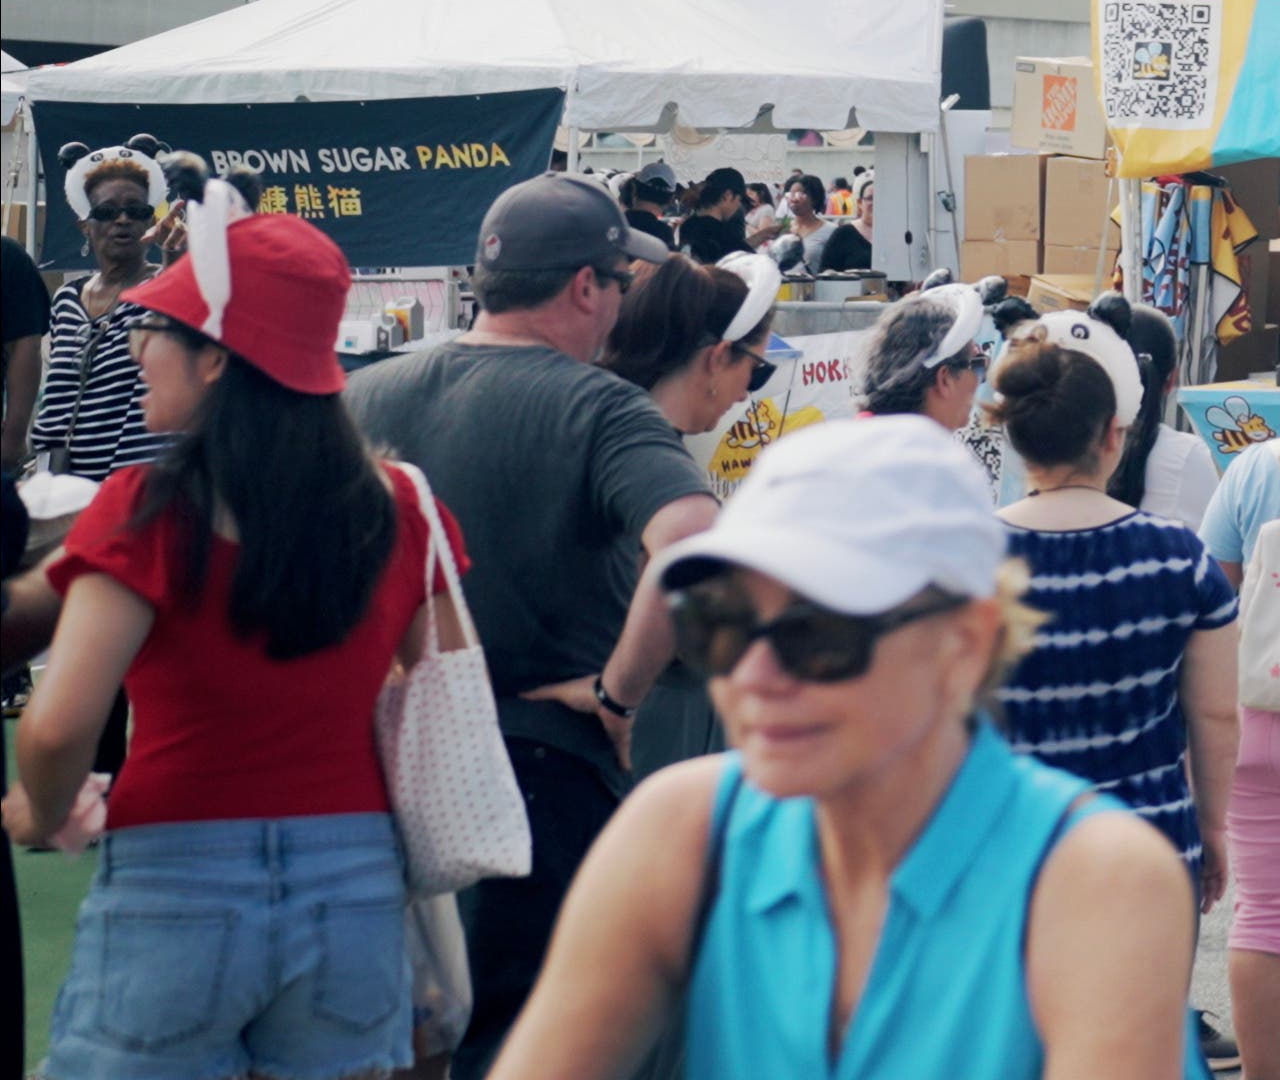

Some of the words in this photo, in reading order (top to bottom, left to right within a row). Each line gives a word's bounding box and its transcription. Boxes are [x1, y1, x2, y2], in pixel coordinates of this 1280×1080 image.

[211, 148, 311, 176] BROWN
[318, 146, 412, 173] SUGAR
[416, 142, 511, 170] PANDA
